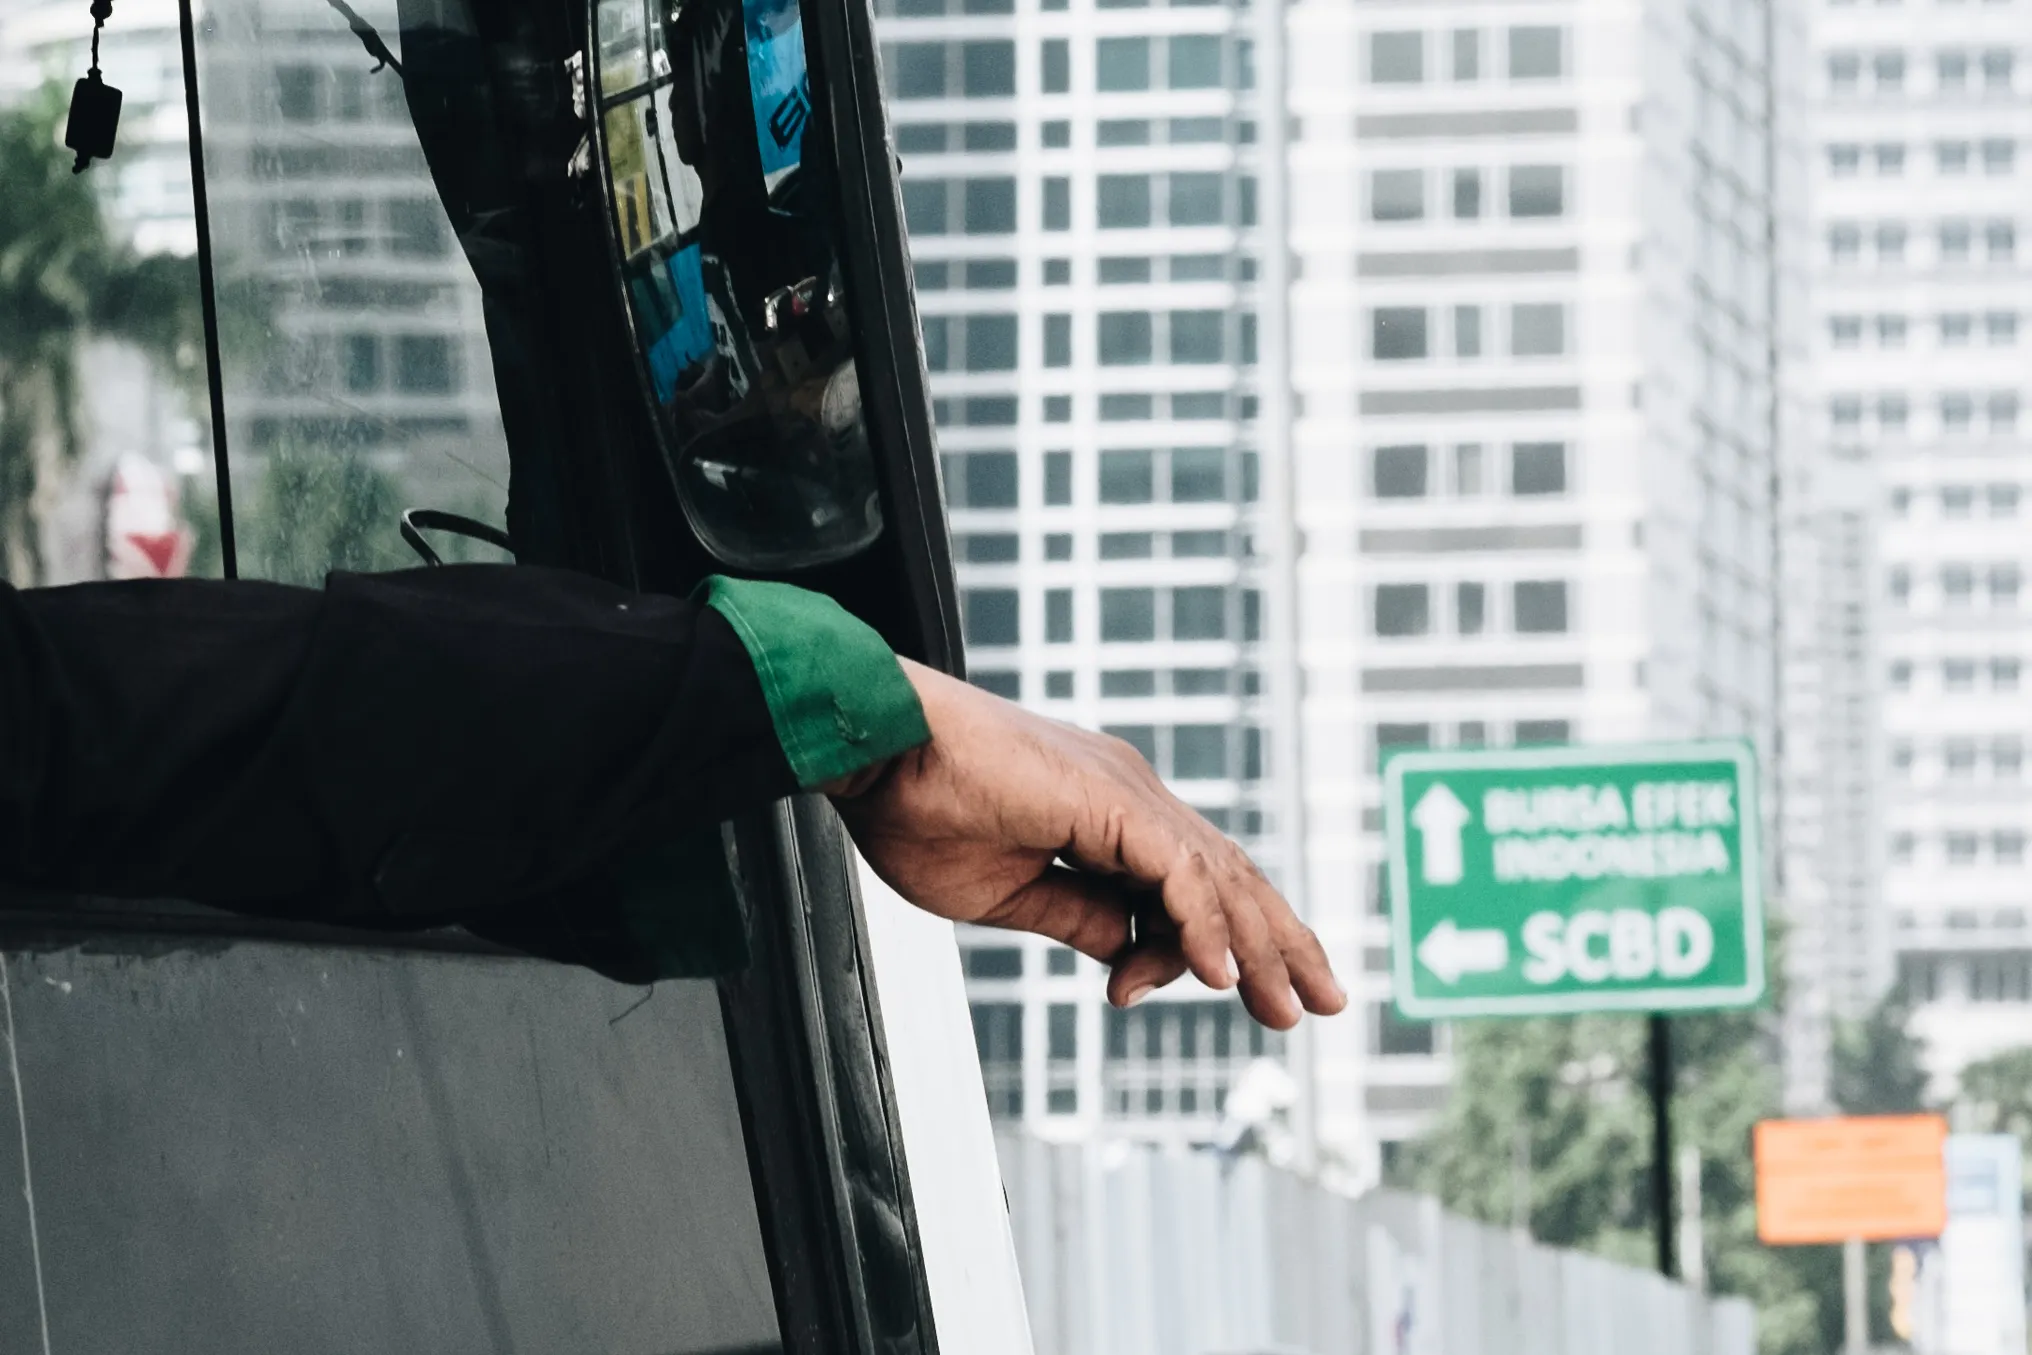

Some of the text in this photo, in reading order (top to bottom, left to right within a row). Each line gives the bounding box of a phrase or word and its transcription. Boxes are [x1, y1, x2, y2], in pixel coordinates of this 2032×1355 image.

[1484, 782, 1733, 833] BURSA EFEK
[1494, 831, 1729, 879] INDONESIA
[1523, 906, 1712, 983] SCBD
